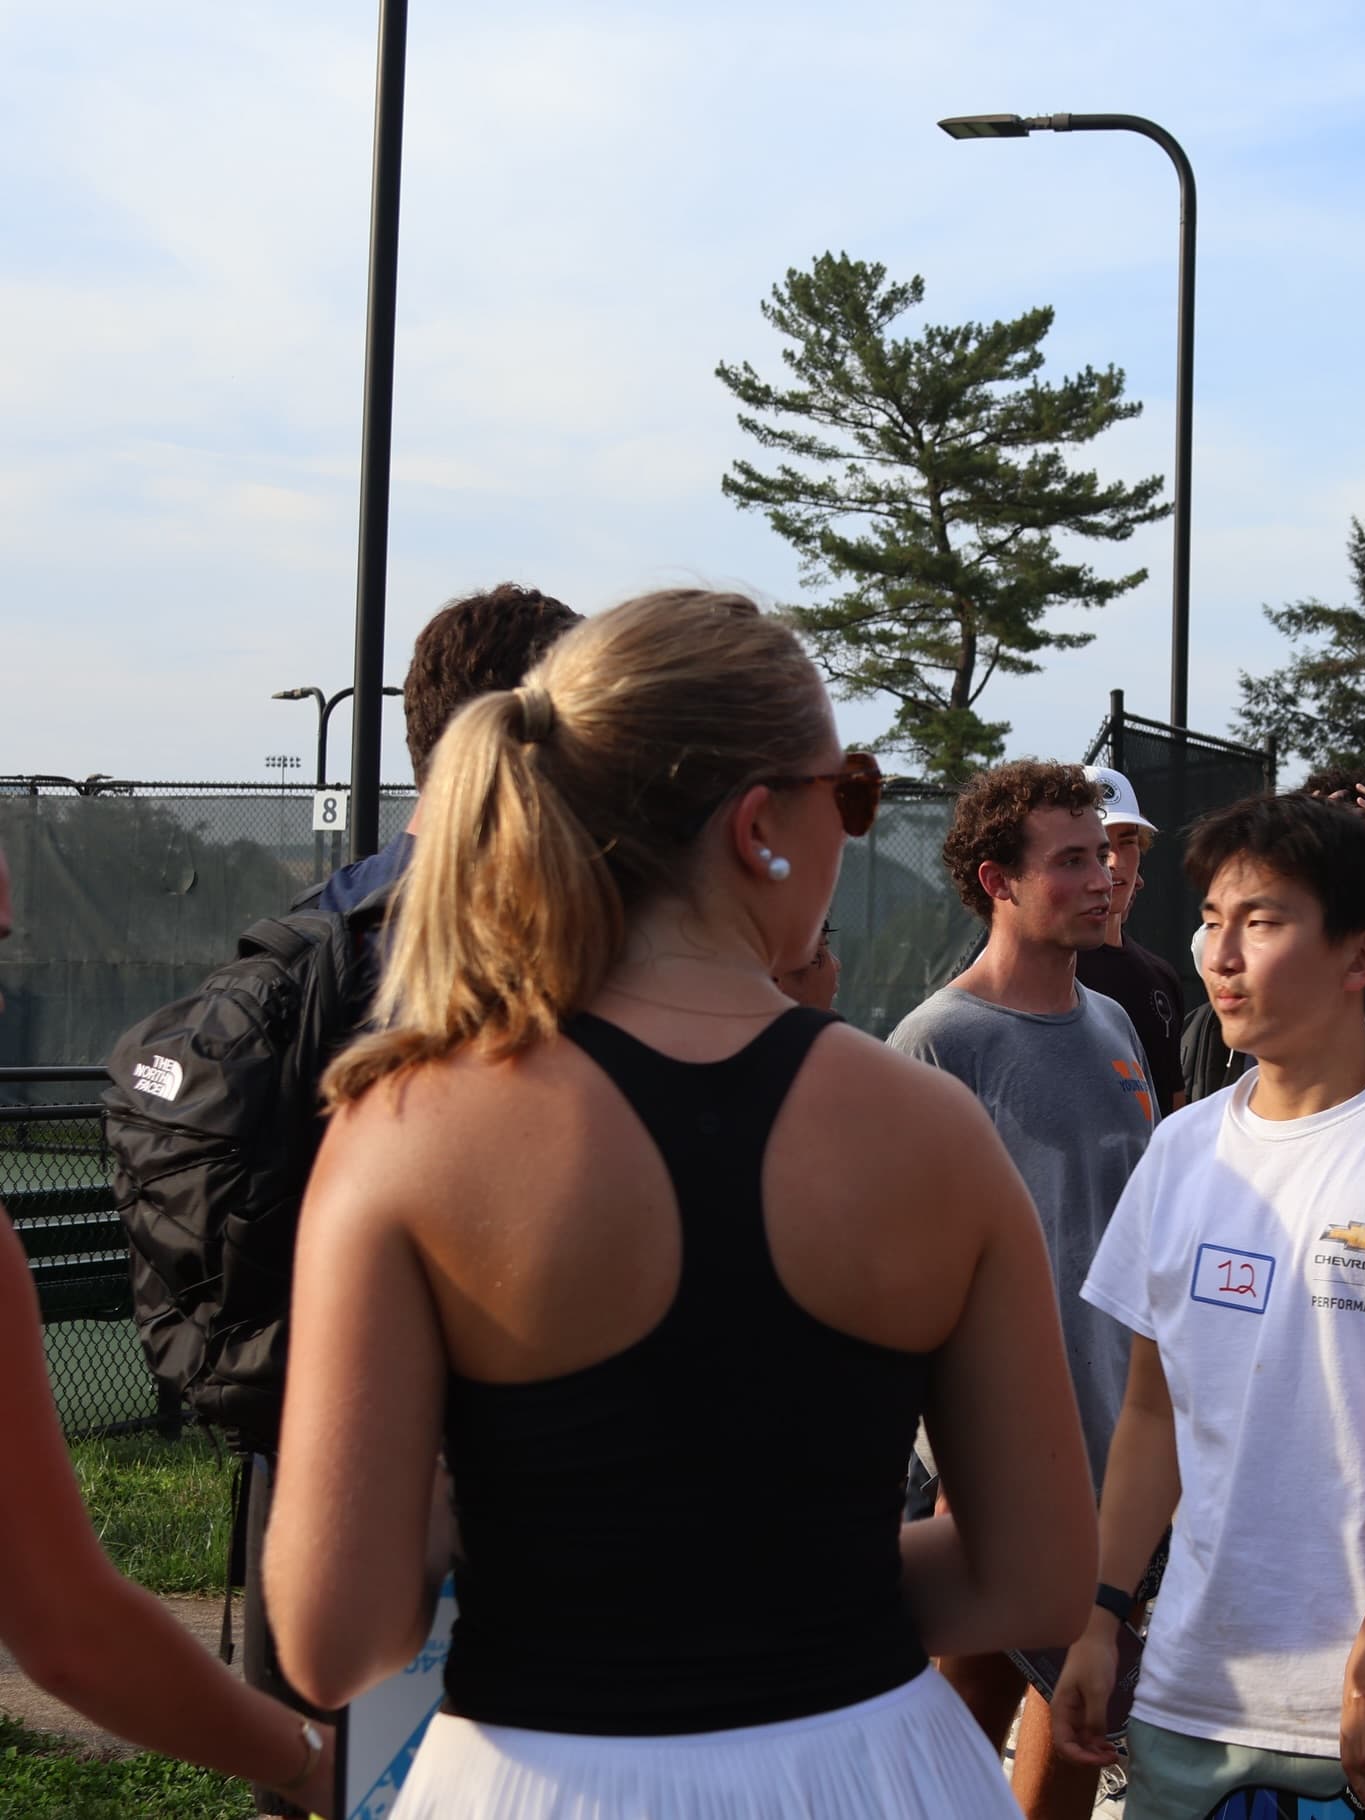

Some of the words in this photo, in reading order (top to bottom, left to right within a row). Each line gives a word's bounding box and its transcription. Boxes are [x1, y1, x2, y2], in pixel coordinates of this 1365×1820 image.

[322, 797, 337, 823] 8
[152, 1054, 177, 1071] THE
[133, 1063, 168, 1084] NORTH
[133, 1079, 164, 1097] FACE
[1217, 1259, 1257, 1298] 12
